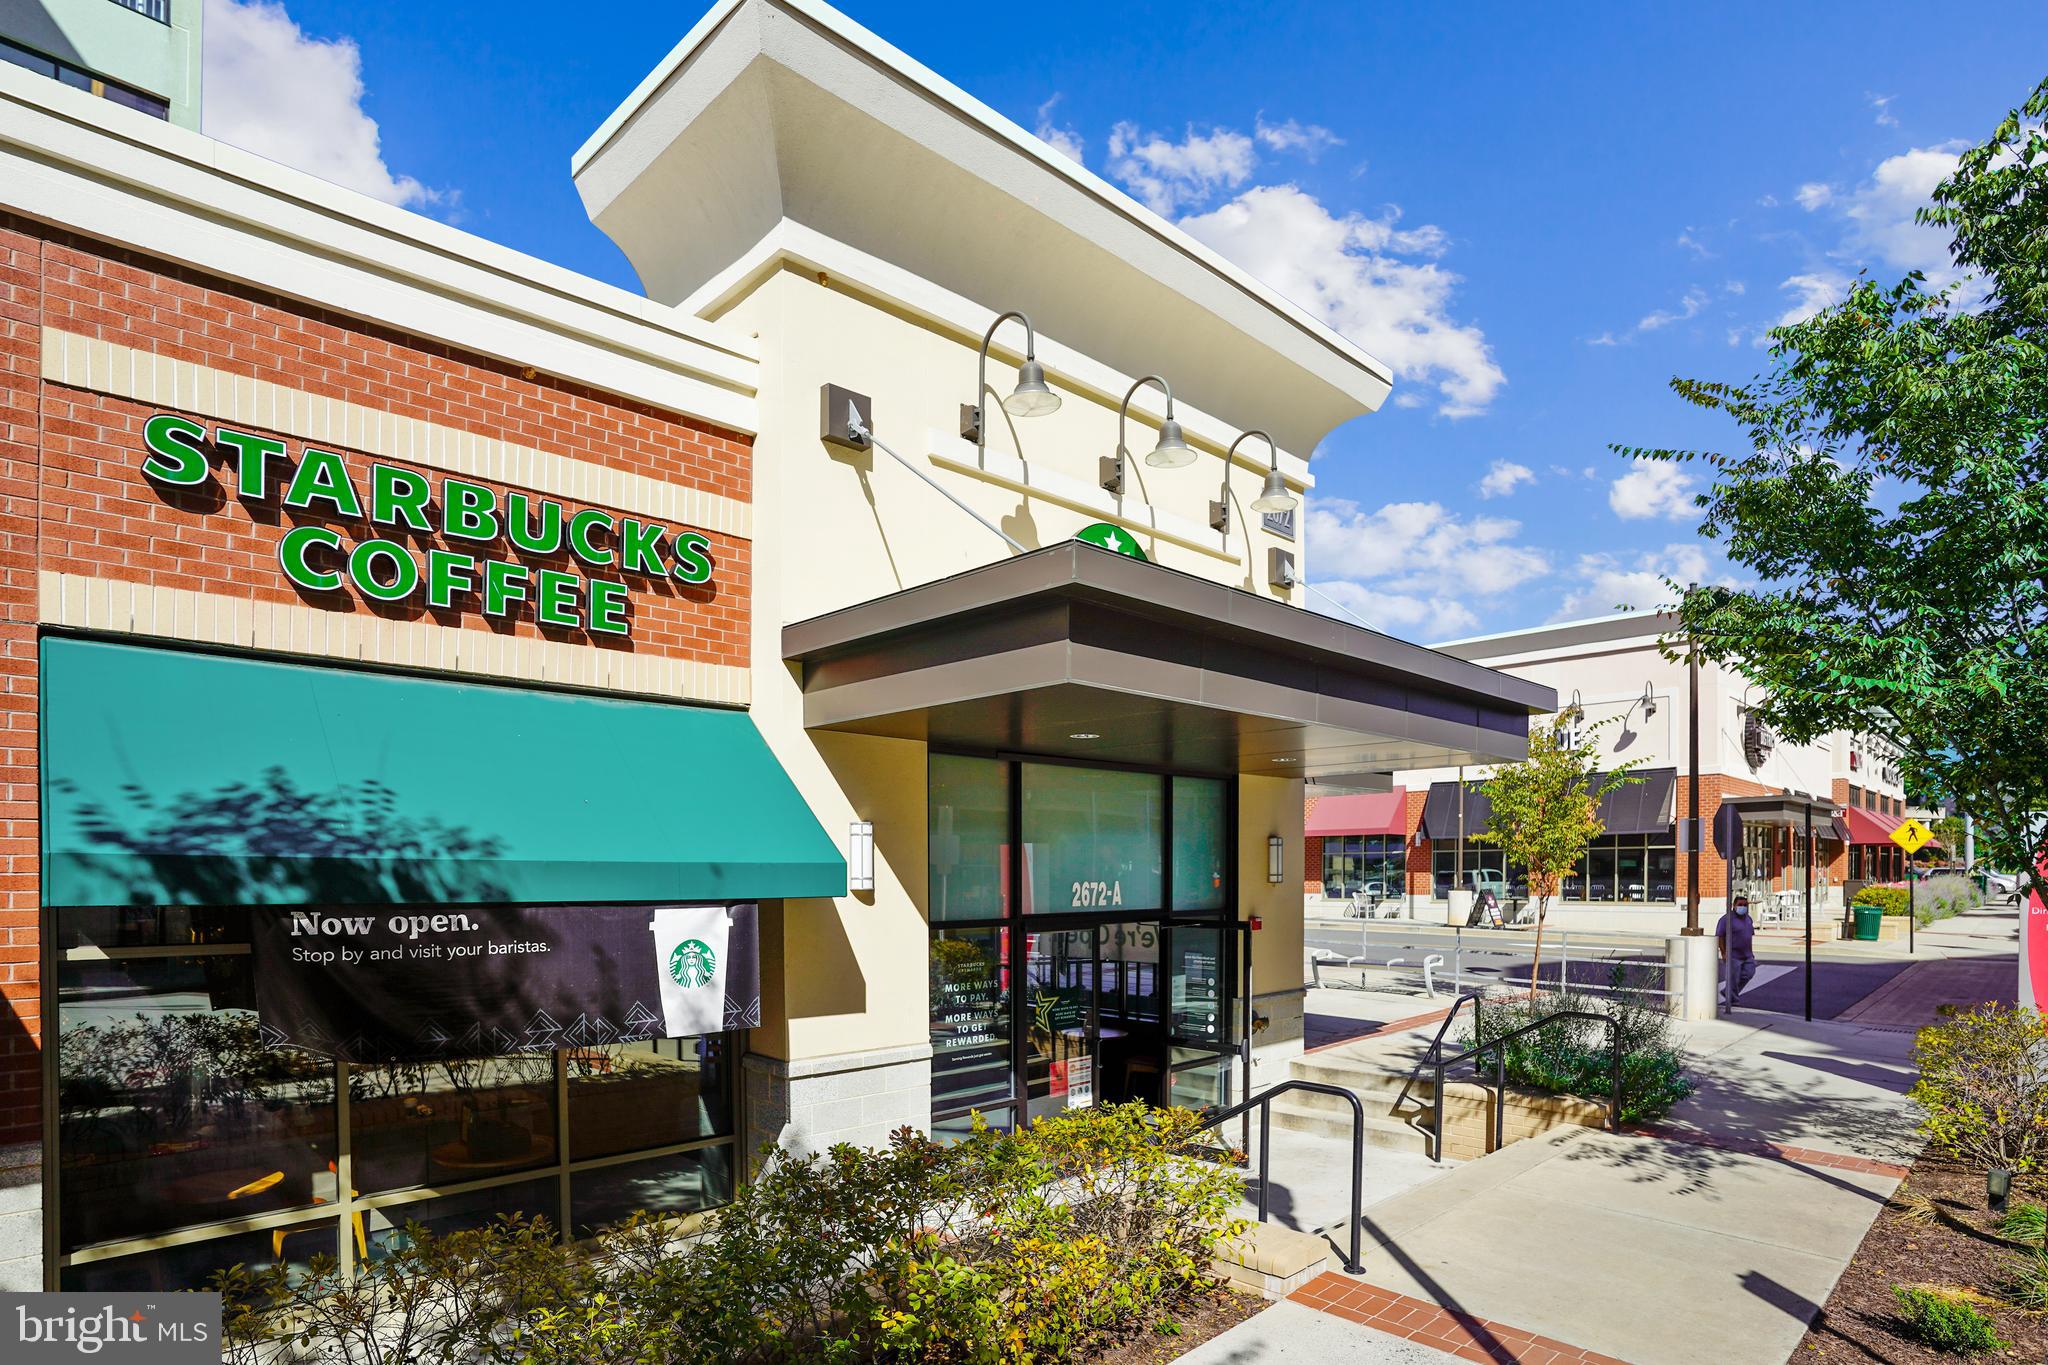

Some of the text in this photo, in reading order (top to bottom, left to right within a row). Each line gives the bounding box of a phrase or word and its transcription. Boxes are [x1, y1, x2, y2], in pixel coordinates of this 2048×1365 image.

[142, 413, 713, 585] STARBUCKS
[279, 526, 630, 636] COFFEE
[1072, 880, 1122, 907] 2672-A
[290, 911, 480, 940] Now open.
[292, 941, 551, 965] Stop by and visit your baristas.
[945, 979, 998, 993] MORE WAYS
[955, 992, 989, 1004] TO PAY.
[945, 1009, 999, 1024] MORE WAYS
[957, 1022, 987, 1034] TO GET
[946, 1033, 998, 1048] REWARDED.
